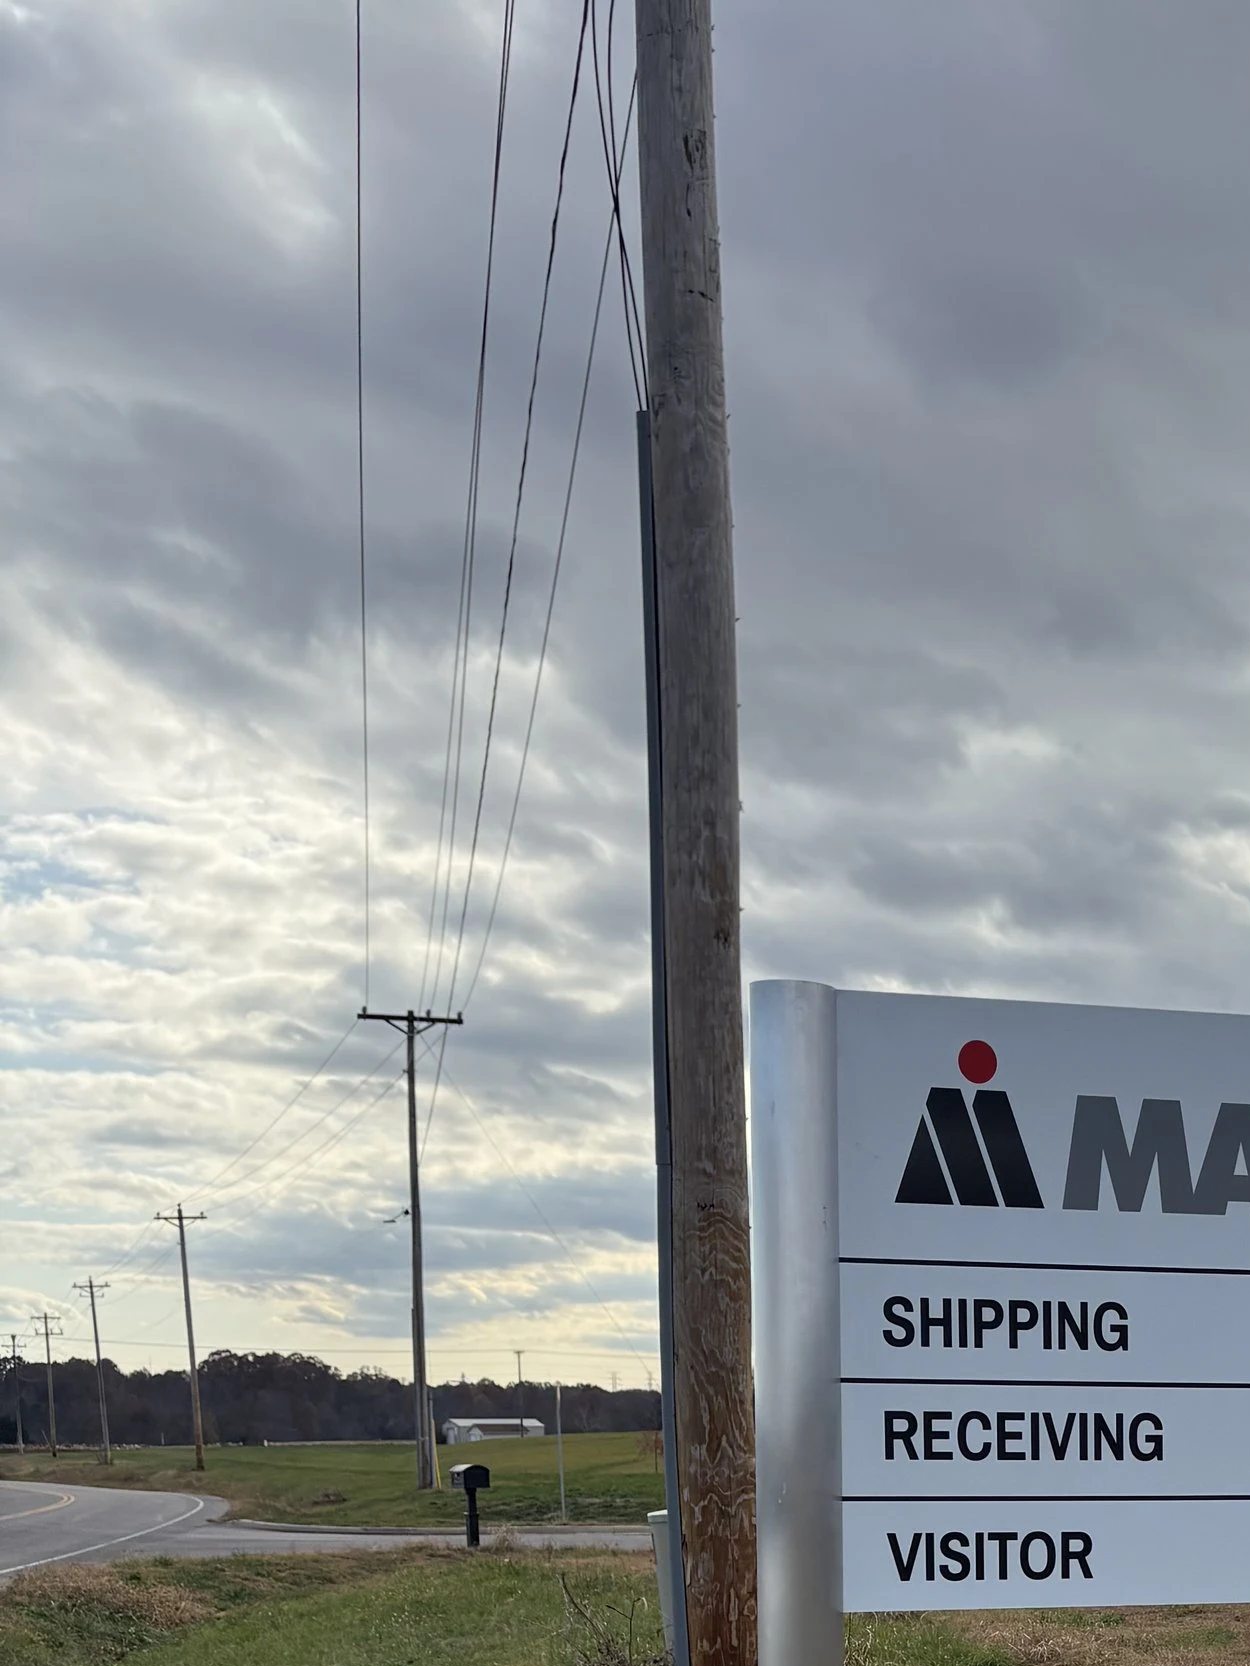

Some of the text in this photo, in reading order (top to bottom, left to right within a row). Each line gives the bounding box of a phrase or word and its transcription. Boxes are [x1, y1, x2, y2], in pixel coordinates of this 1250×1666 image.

[883, 1296, 1129, 1352] SHIPPING
[884, 1410, 1165, 1462] RECEIVING
[887, 1530, 1094, 1582] VISITOR
